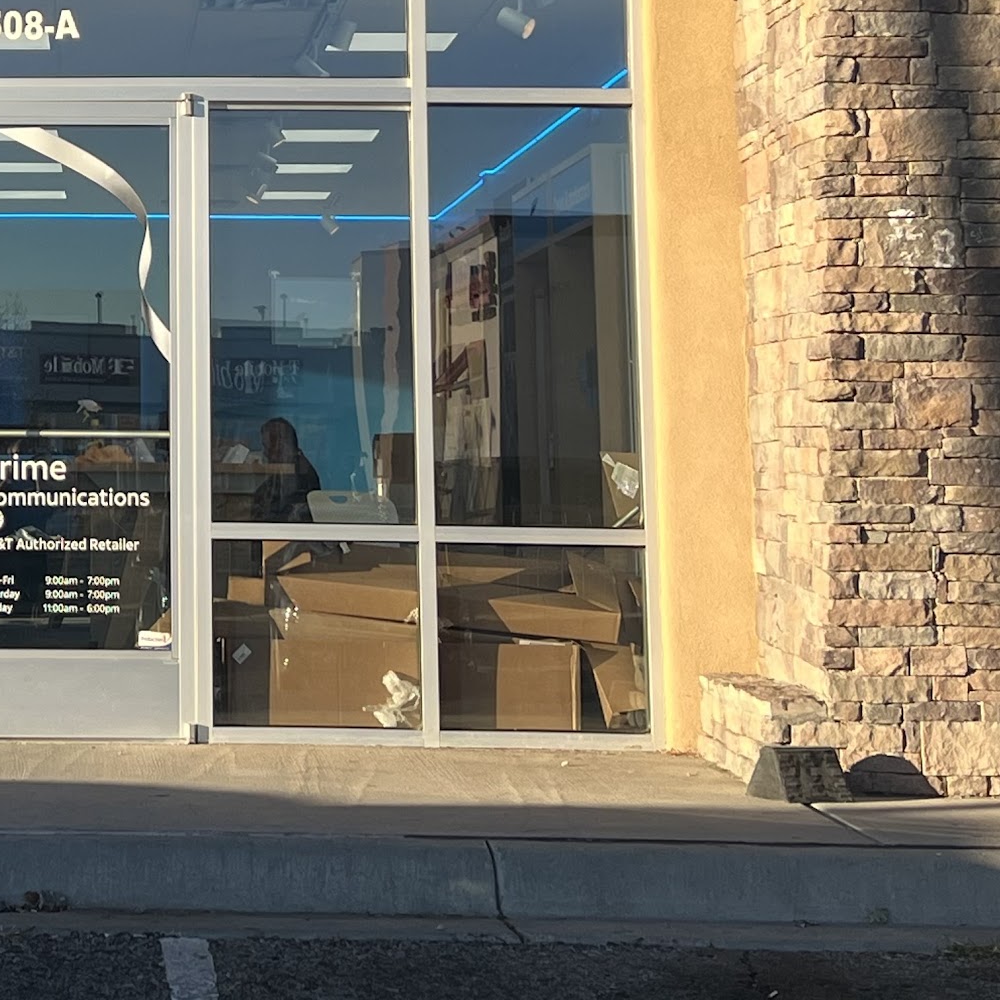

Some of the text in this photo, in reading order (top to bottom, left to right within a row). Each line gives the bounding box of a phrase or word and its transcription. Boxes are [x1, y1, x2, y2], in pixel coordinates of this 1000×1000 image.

[16, 536, 87, 551] Authorized
[90, 537, 140, 551] Retailer
[45, 576, 78, 586] 9:00am
[87, 576, 120, 587] 7:00pm
[45, 590, 78, 600] 9:00am
[87, 590, 120, 601] 7:00pm
[43, 604, 78, 614] 11:00am
[87, 604, 120, 615] 6:00pm
